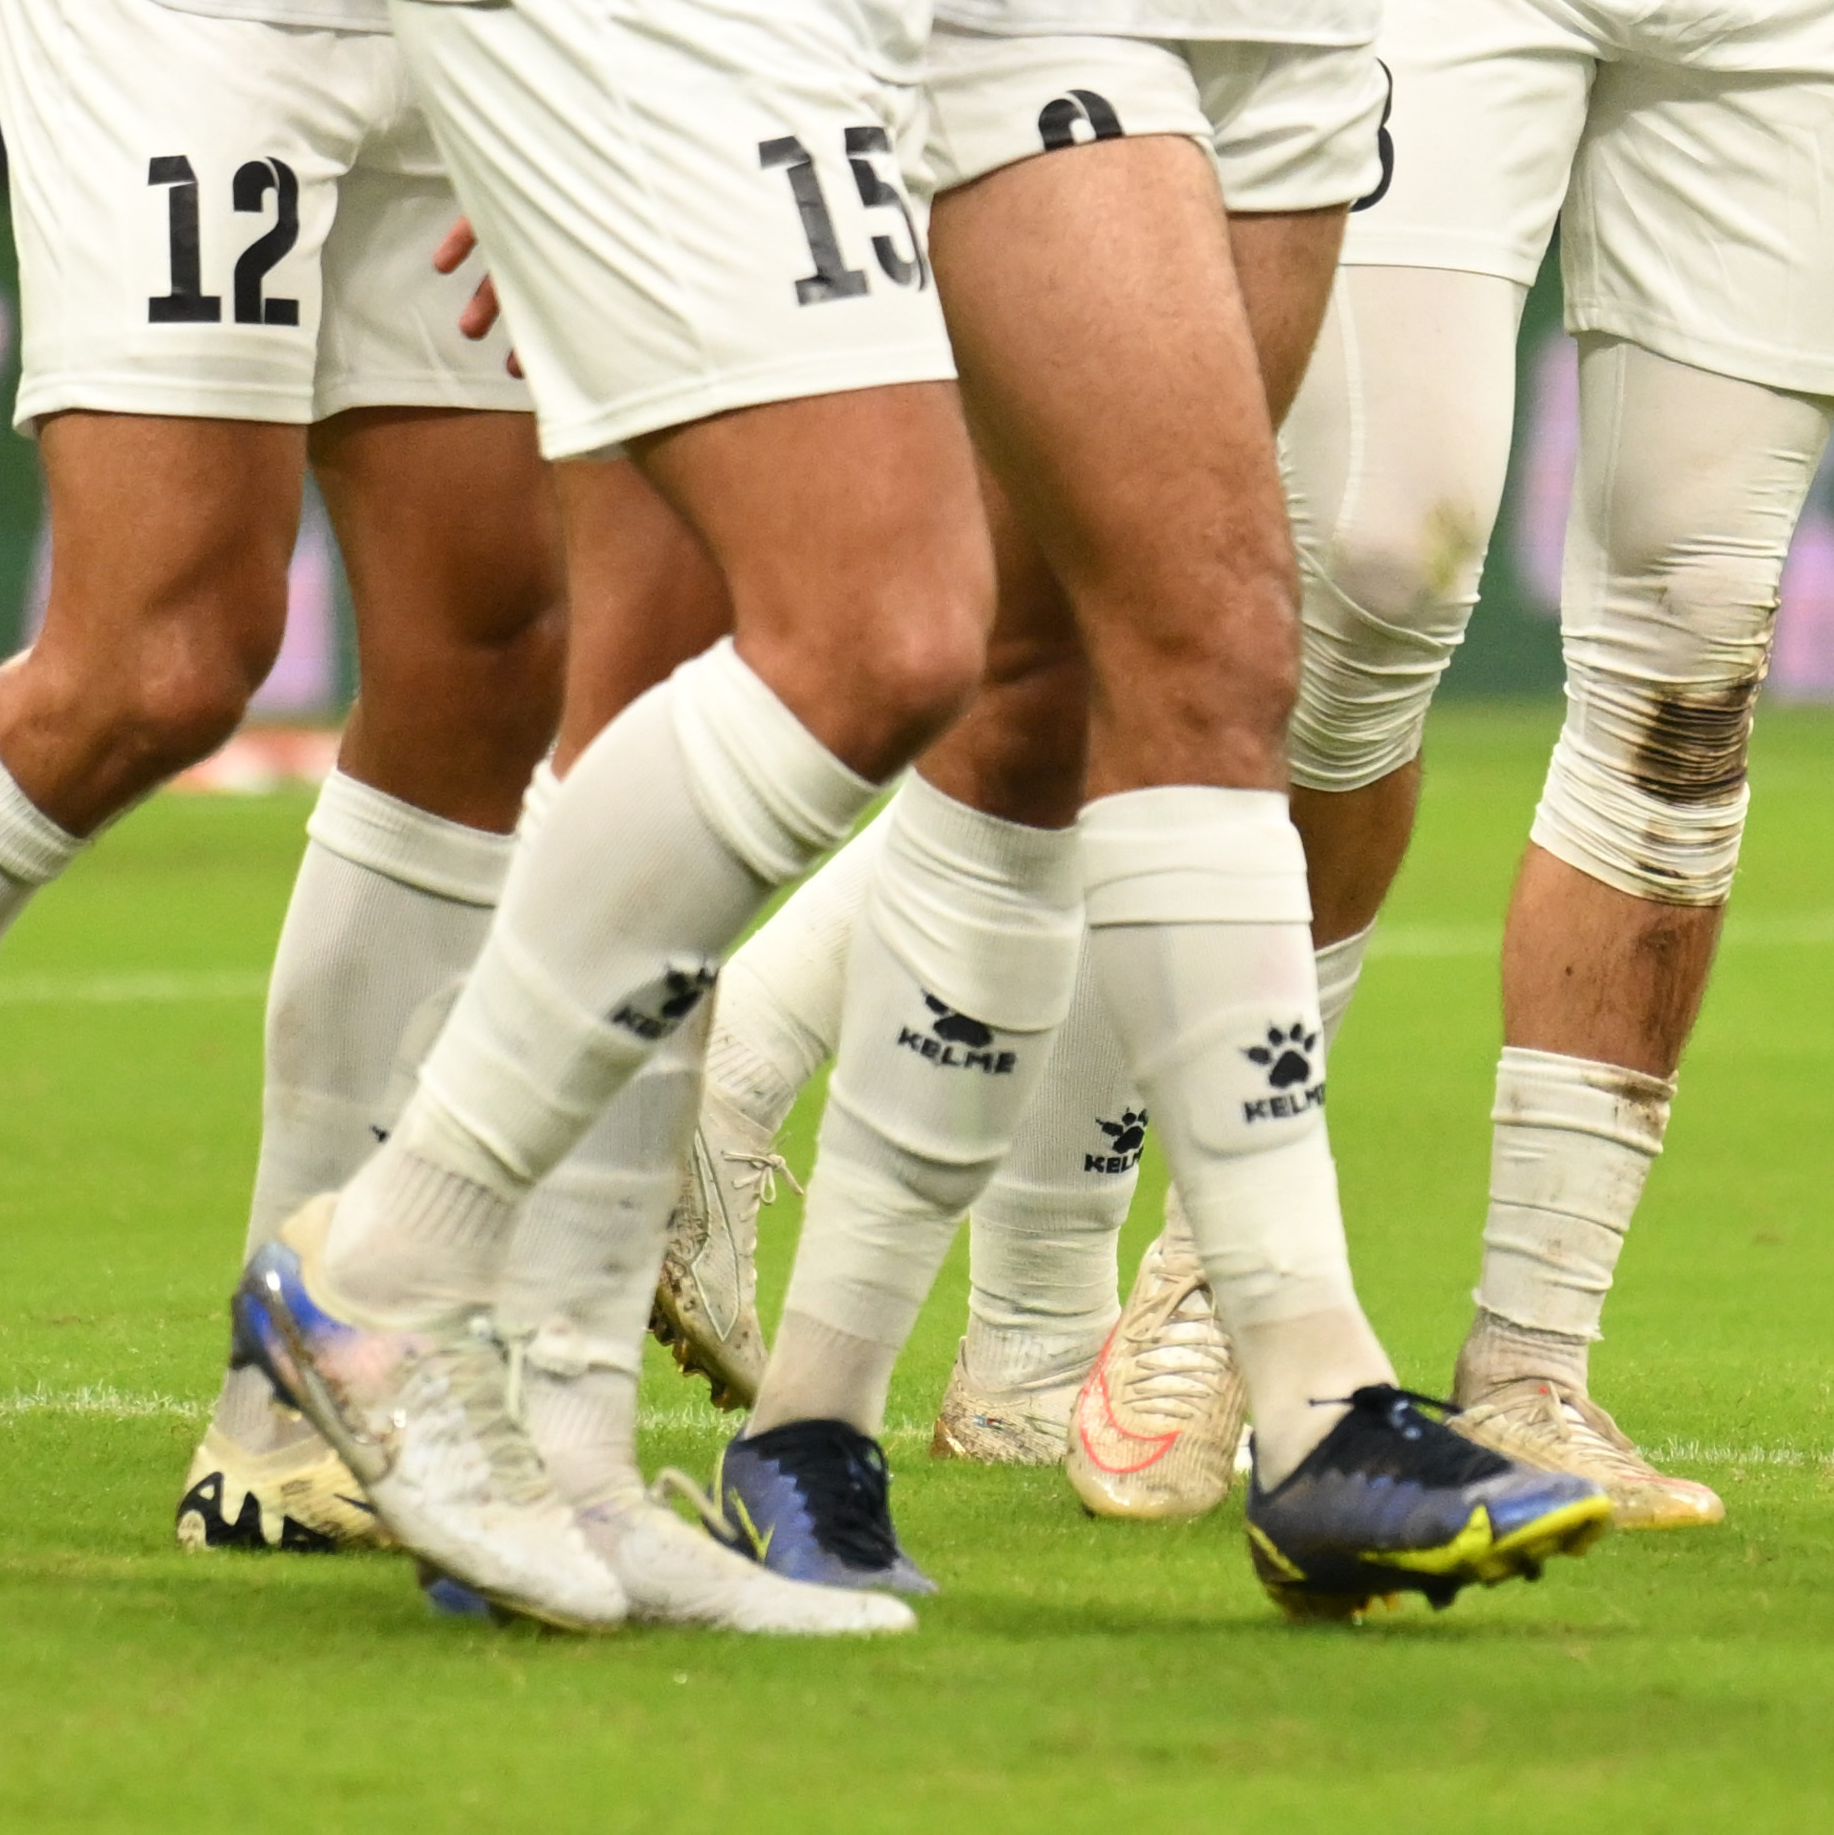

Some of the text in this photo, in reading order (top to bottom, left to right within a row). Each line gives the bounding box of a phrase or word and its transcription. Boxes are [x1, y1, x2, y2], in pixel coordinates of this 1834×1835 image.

[148, 154, 300, 326] 12
[758, 126, 931, 307] 15
[897, 1027, 1018, 1074] KELME
